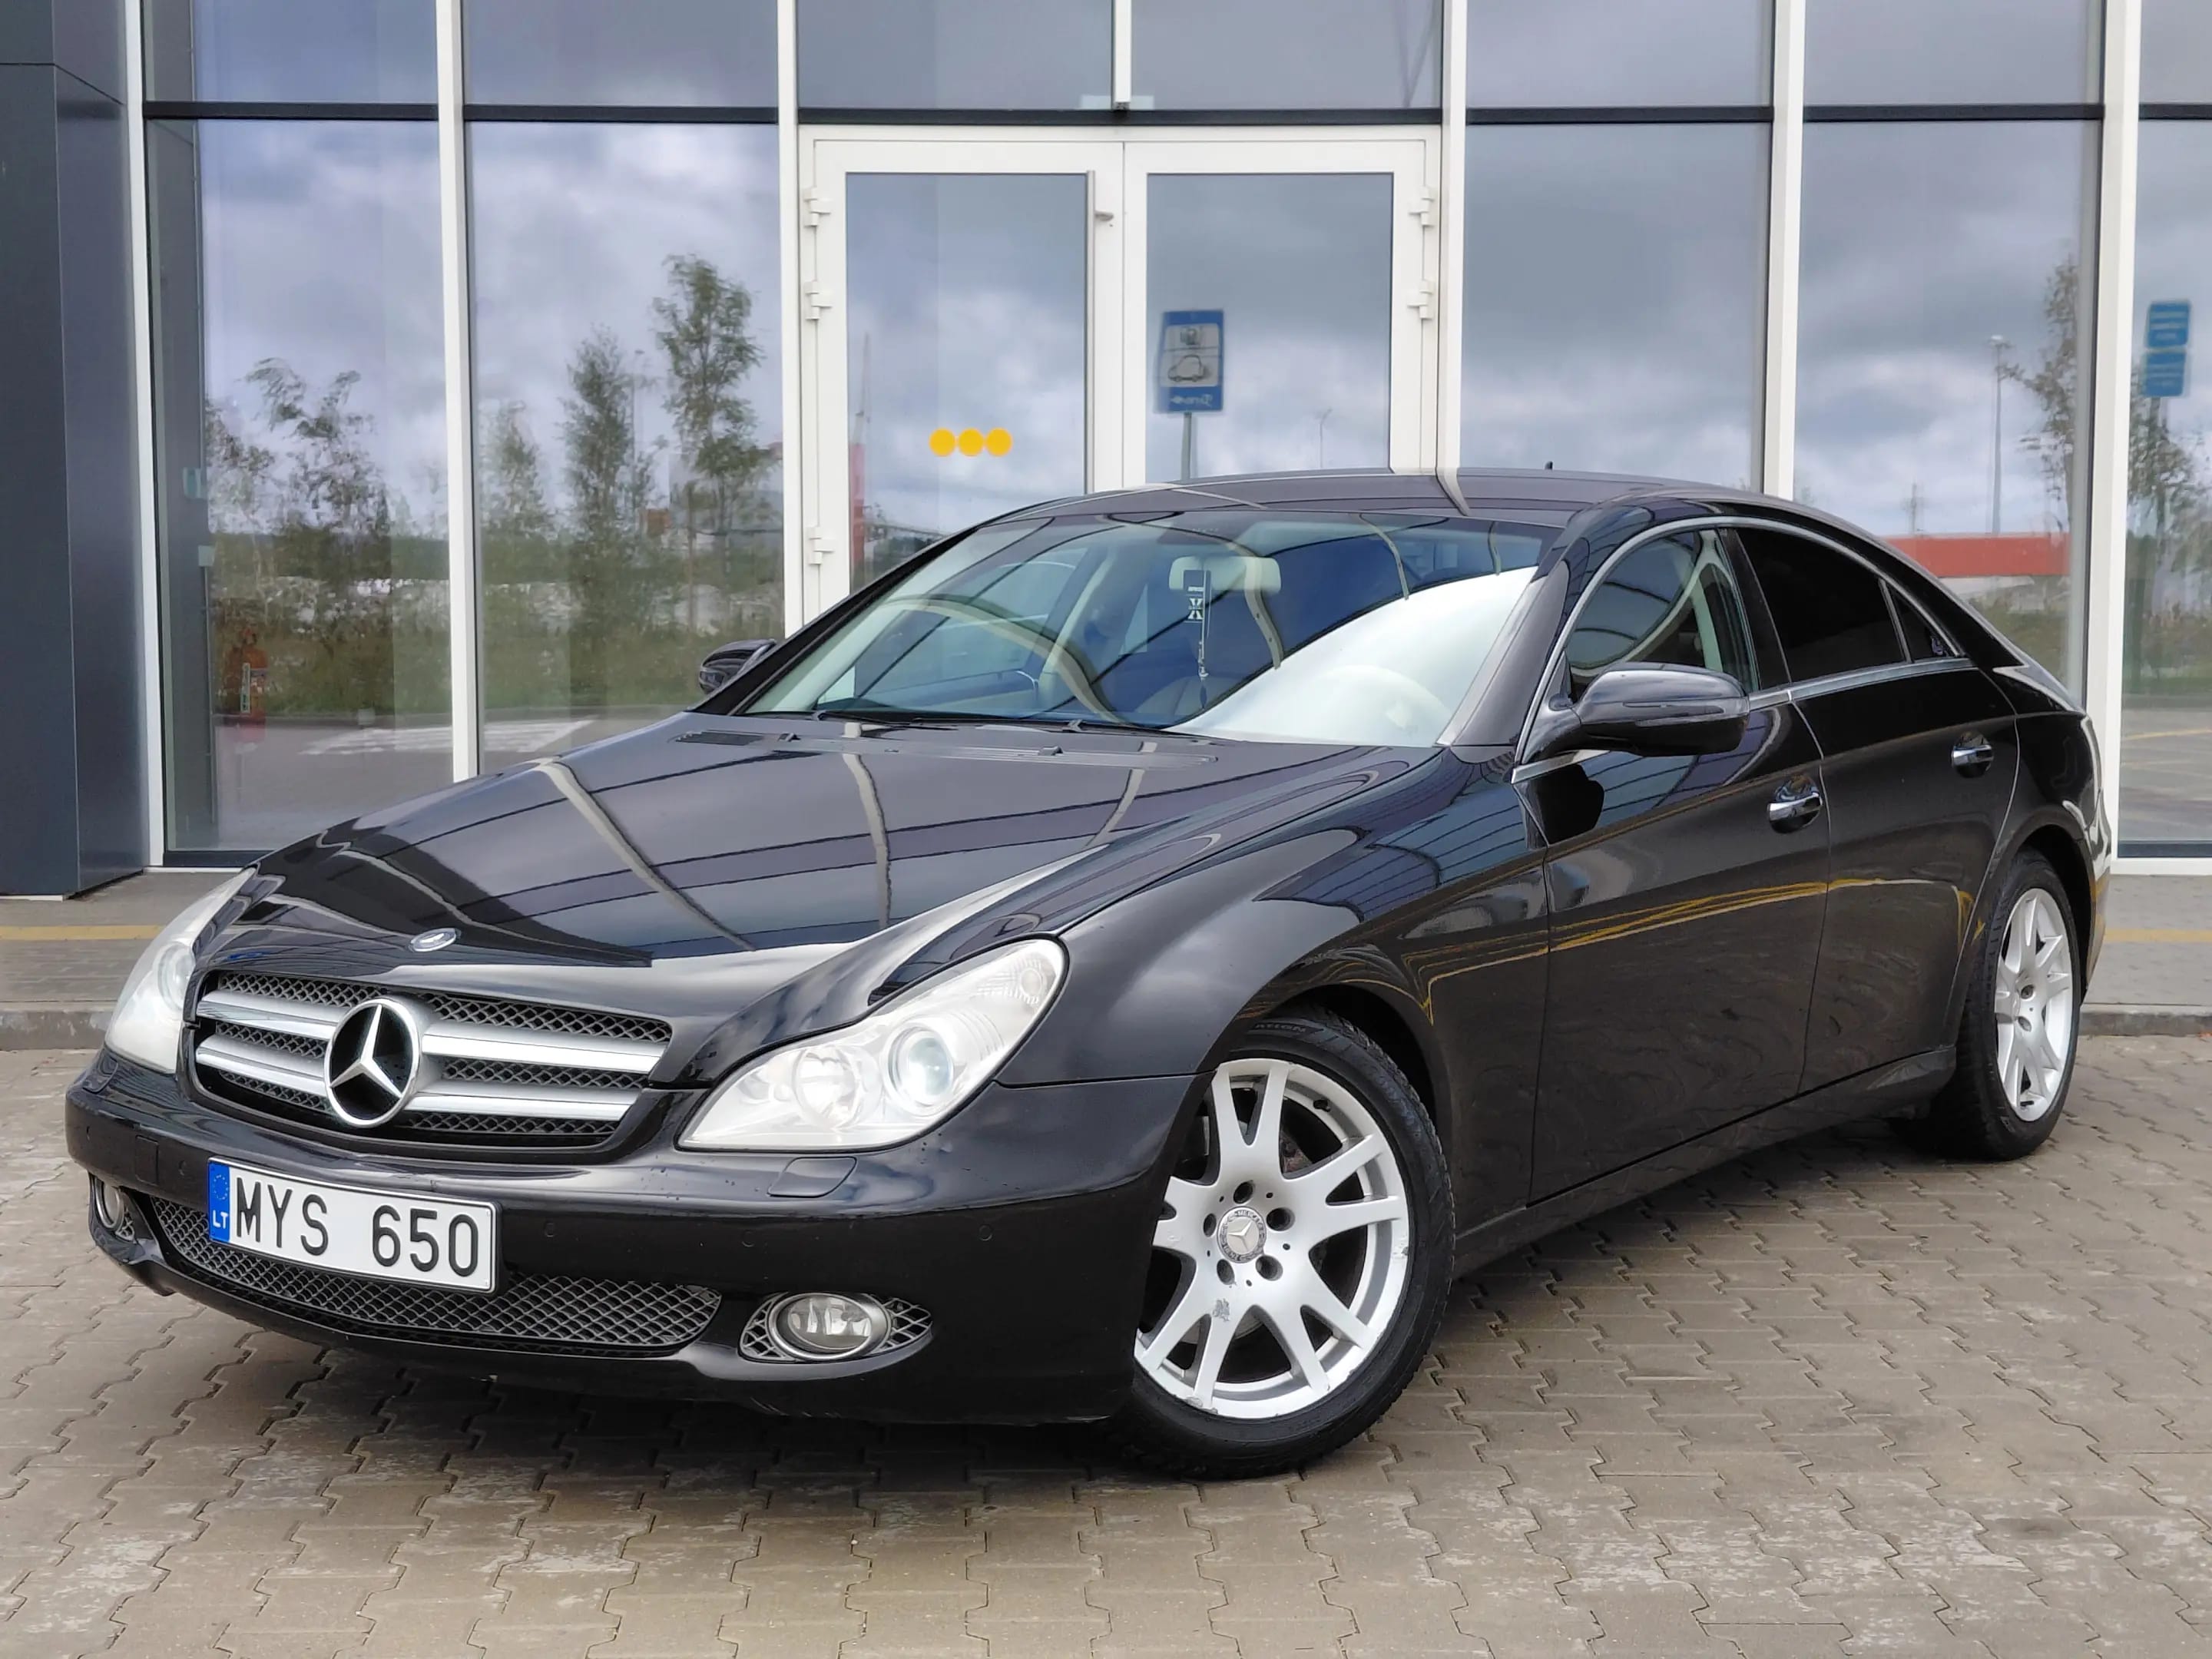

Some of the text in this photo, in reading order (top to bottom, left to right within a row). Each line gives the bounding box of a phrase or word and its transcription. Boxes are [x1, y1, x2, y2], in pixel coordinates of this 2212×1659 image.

[212, 1210, 229, 1229] LT
[236, 1177, 478, 1277] MYS 650
